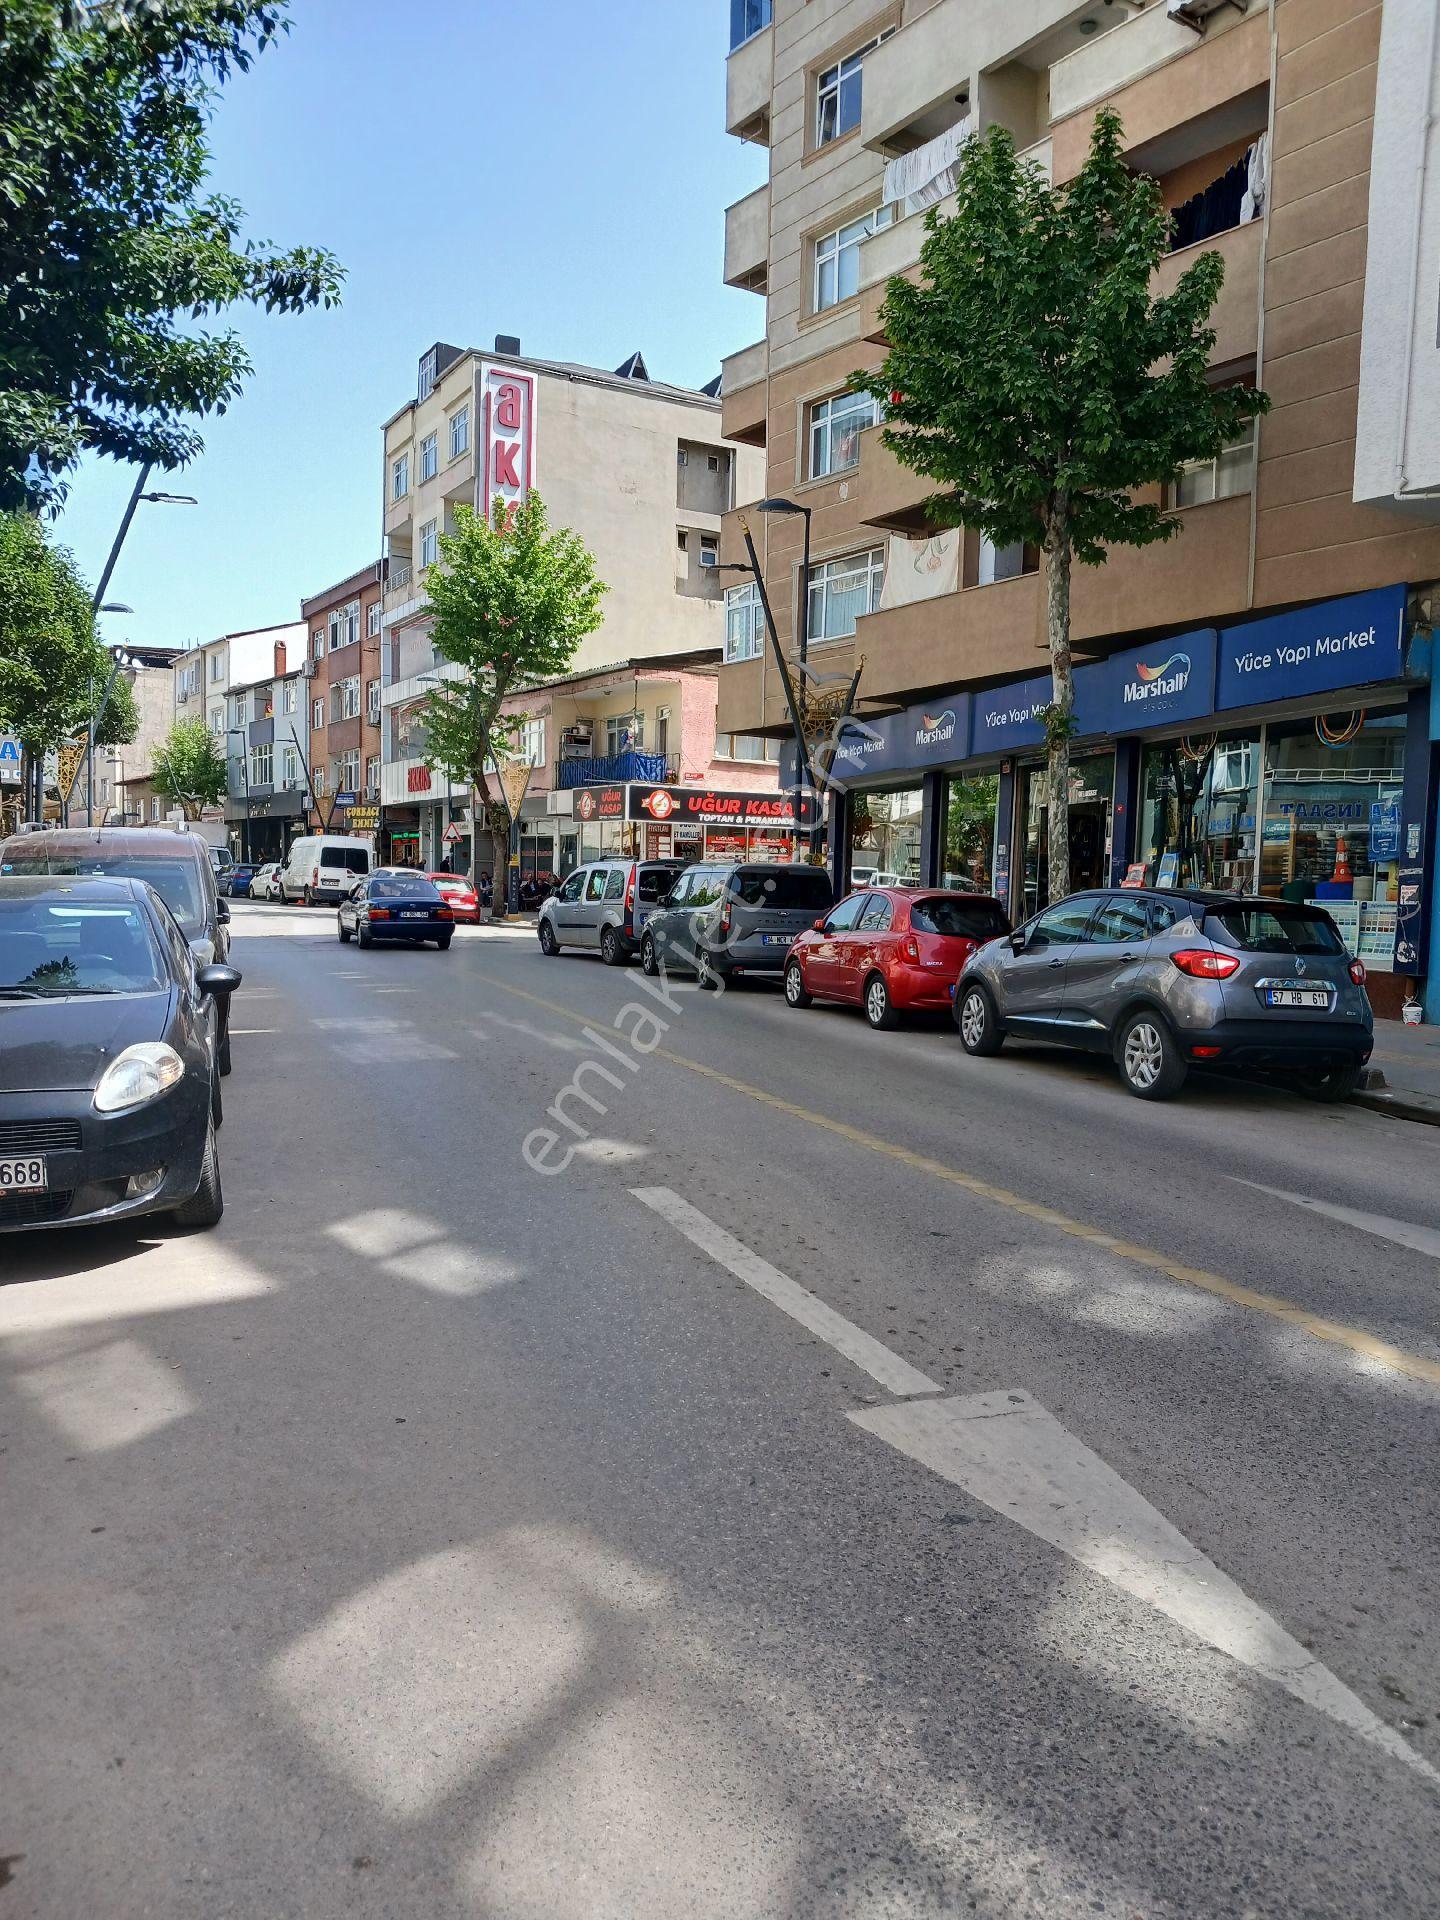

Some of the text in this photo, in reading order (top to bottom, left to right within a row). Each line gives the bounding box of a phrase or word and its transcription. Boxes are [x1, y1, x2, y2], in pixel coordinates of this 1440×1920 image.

[1235, 626, 1376, 674] Yüce Yapı Market
[1124, 672, 1187, 703] Marshall
[985, 711, 1006, 727] Yüce
[1009, 708, 1029, 723] Yapı
[915, 725, 953, 746] Marshall
[863, 738, 885, 754] Market
[601, 788, 621, 802] UĞUR
[688, 792, 742, 814] UĞUR
[599, 803, 622, 814] KASAP
[698, 814, 734, 823] TOPTAN
[735, 815, 743, 823] &
[1273, 992, 1325, 1005] 57 HB 611
[0, 1161, 41, 1185] 668
